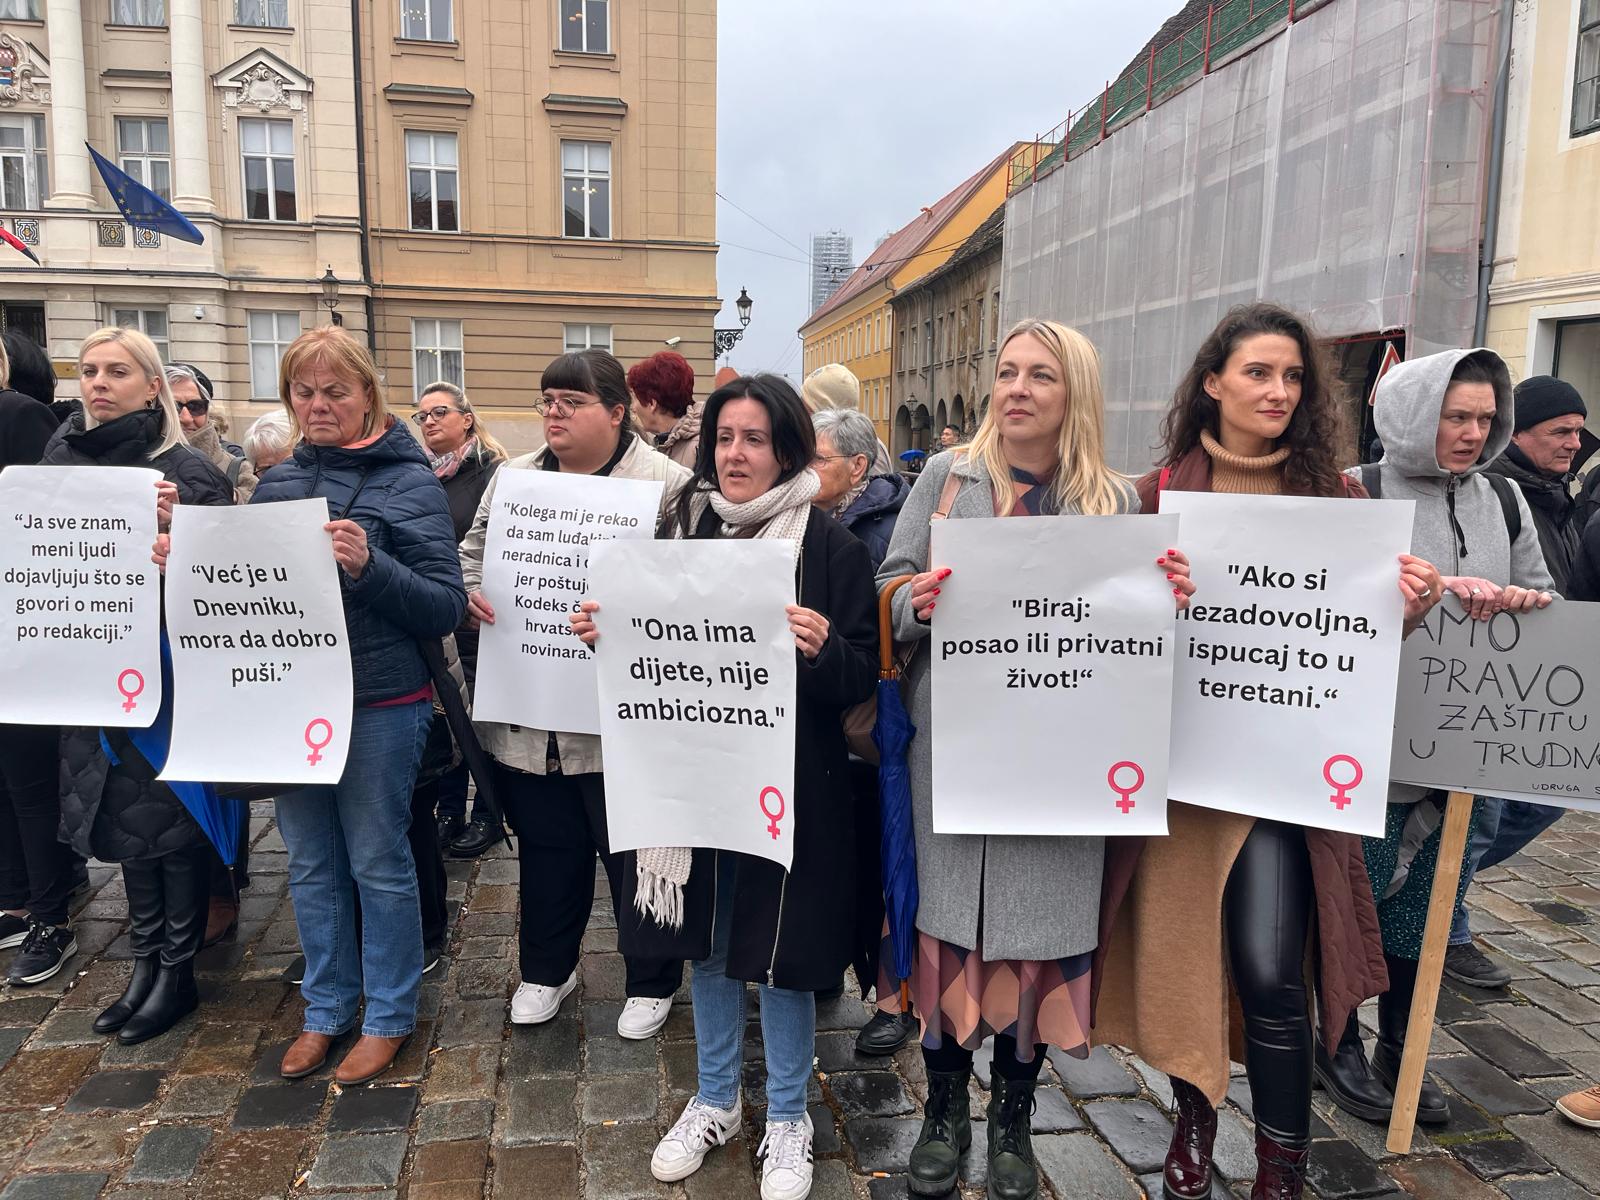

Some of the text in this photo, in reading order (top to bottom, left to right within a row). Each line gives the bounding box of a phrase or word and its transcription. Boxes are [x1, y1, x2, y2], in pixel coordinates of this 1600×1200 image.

[47, 517, 77, 530] sve
[81, 518, 132, 534] znam,
[504, 502, 638, 528] "Kolega mi je rekao
[506, 525, 524, 539] da
[526, 530, 555, 542] sam
[31, 541, 116, 562] meni ljudi
[501, 550, 572, 568] neradnica
[576, 554, 580, 568] i
[4, 567, 145, 589] dojavljuju što se
[245, 563, 268, 589] je
[272, 567, 288, 582] u
[513, 571, 589, 595] jer poštuj
[1228, 564, 1328, 591] "Ako si
[15, 595, 133, 615] govori o meni
[192, 596, 305, 620] Dnevniku,
[515, 594, 568, 613] Kodeks
[1012, 597, 1090, 623] "Biraj:
[17, 623, 133, 645] po redakciji.”
[178, 628, 338, 649] mora da dobro
[524, 617, 575, 637] hrvats
[631, 617, 757, 644] "Ona ima
[520, 642, 592, 661] novinara.
[942, 632, 1163, 661] posao ili privatni
[1188, 636, 1355, 673] ispucaj to u
[231, 662, 292, 688] puši.”
[629, 656, 769, 691] dijete, nije
[1418, 656, 1584, 706] PRAVO
[617, 697, 785, 729] ambiciozna."
[1437, 703, 1588, 732] ZAŠTITU
[1409, 738, 1436, 760] U
[1531, 783, 1581, 793] UDRUGA
